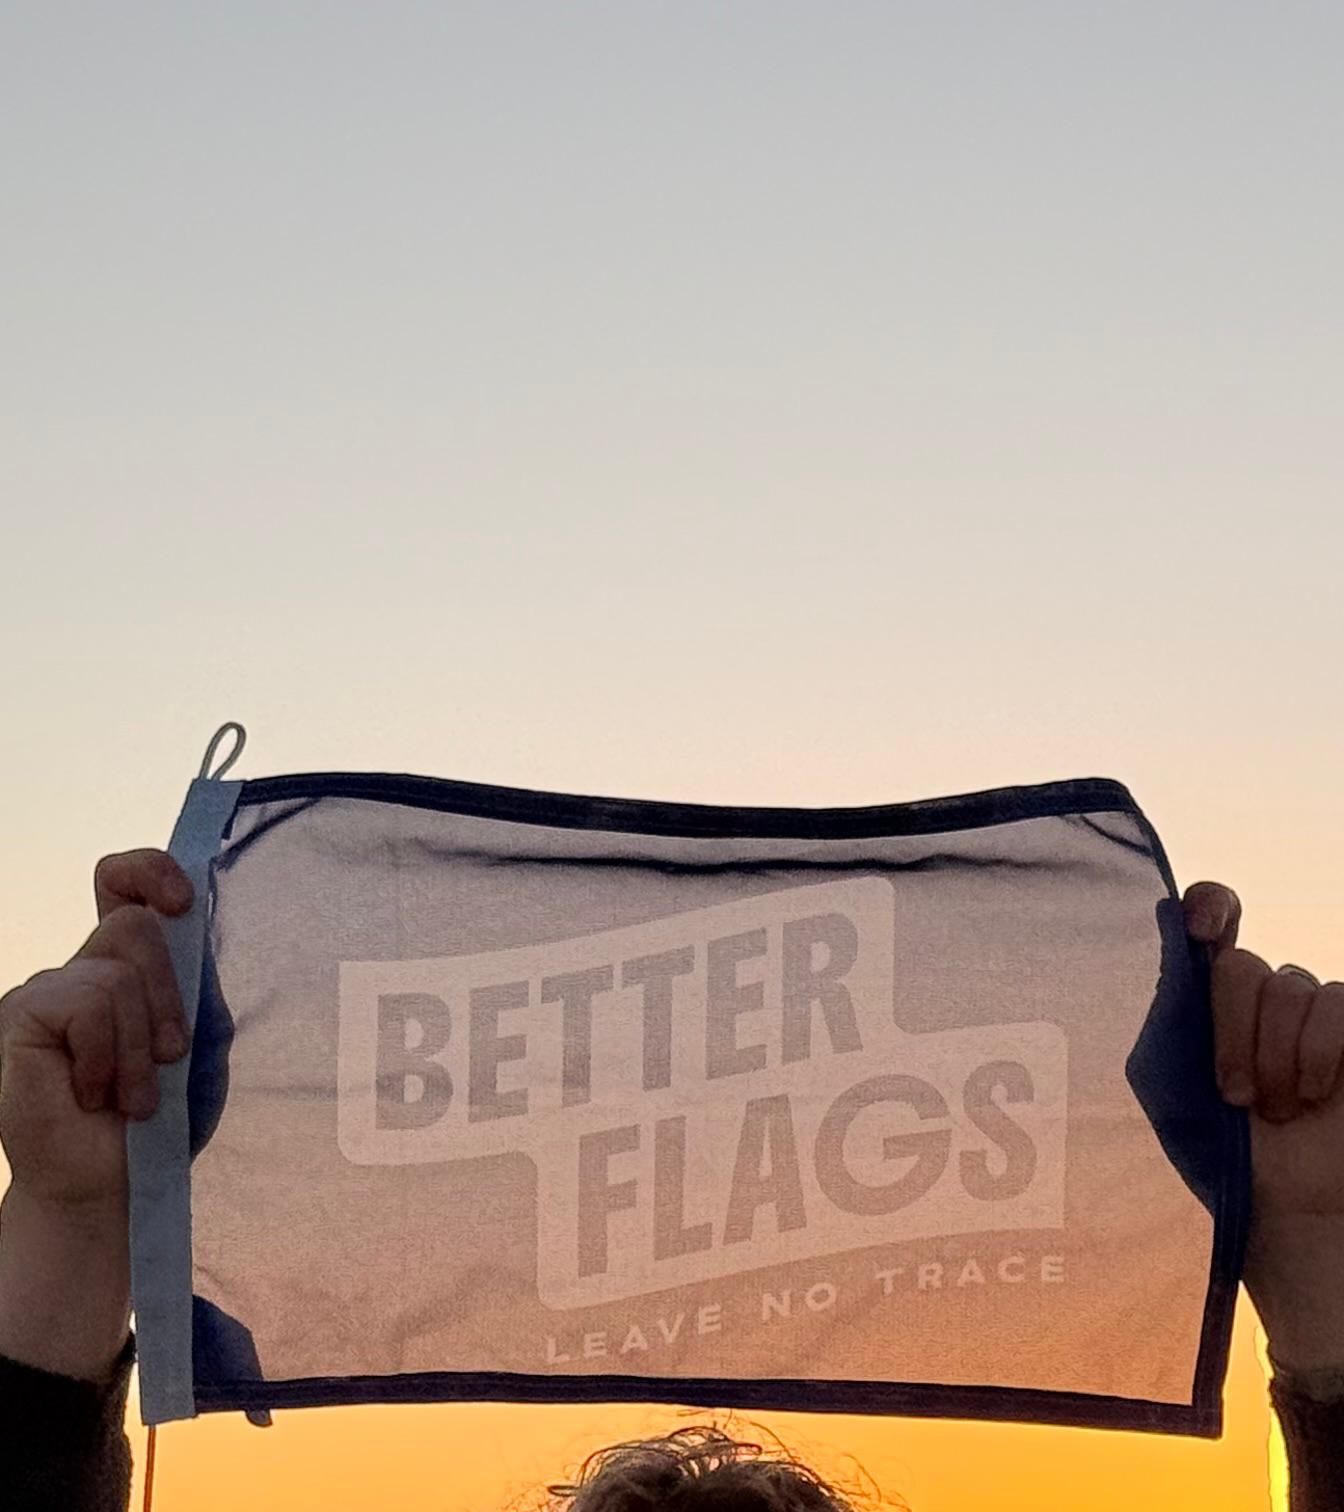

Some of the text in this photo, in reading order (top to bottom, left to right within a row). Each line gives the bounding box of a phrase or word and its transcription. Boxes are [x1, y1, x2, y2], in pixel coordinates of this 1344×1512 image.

[374, 913, 863, 1131] BETTER
[577, 1061, 1035, 1277] FLAGS
[546, 1254, 1066, 1364] LEAVE NO TRACE
